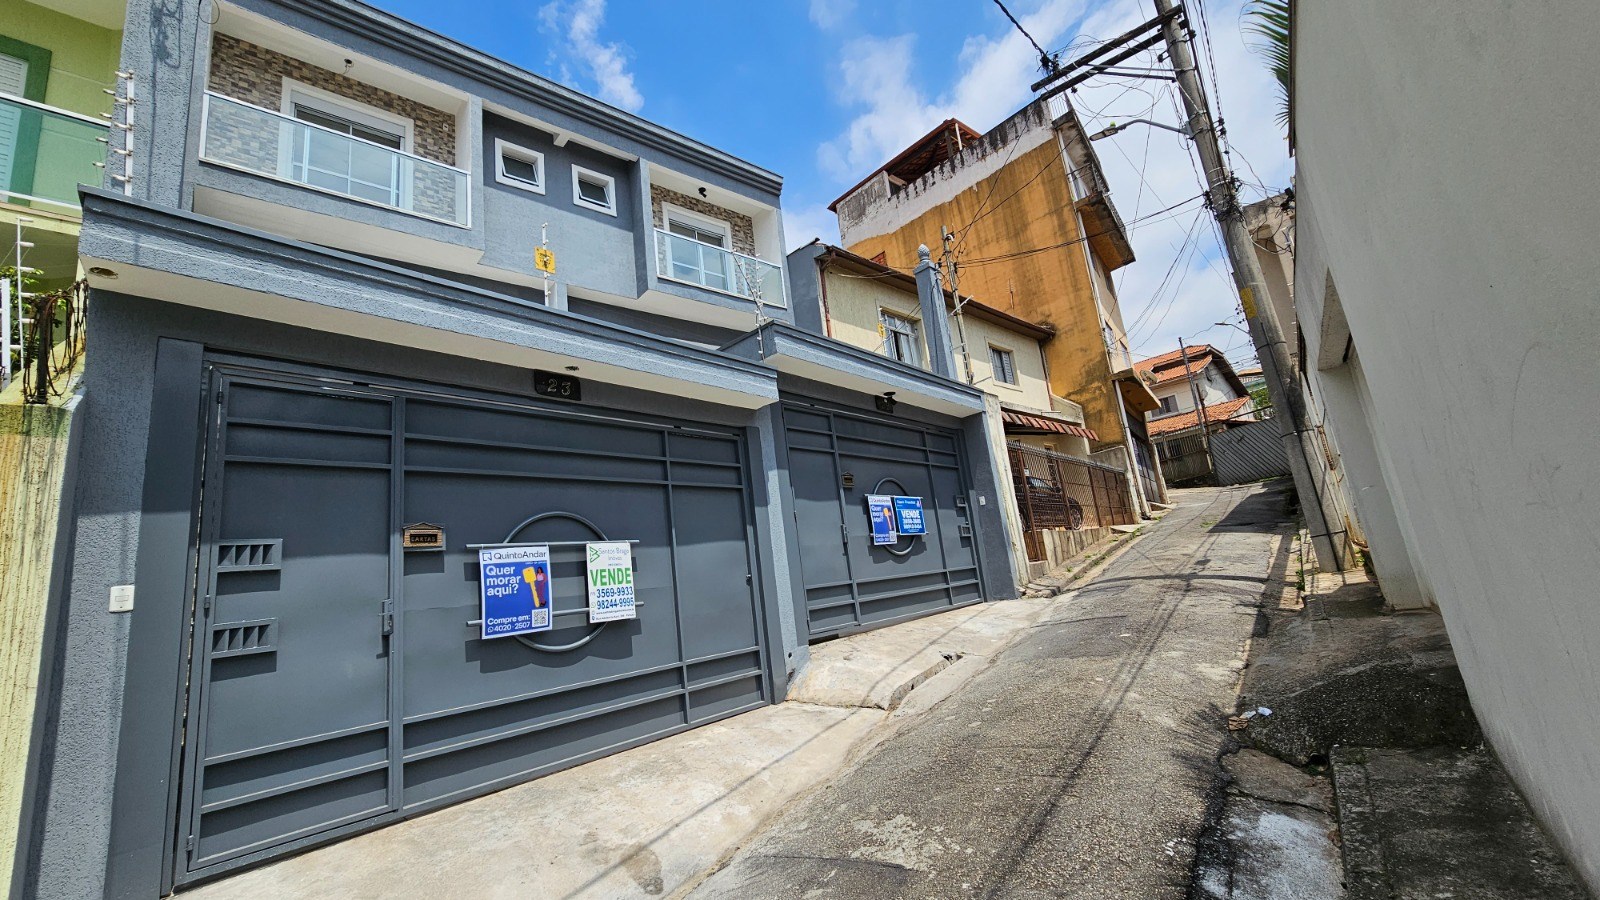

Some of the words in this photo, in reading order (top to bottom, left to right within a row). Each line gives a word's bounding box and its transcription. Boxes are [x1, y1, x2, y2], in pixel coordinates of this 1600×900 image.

[547, 378, 571, 396] 23
[901, 510, 921, 518] VENDE
[493, 550, 546, 560] QuintoAndar
[486, 565, 515, 576] Quer
[486, 575, 521, 586] morar
[590, 567, 632, 587] VENDE
[487, 584, 519, 597] aqui?
[596, 586, 633, 599] 3569-9933
[597, 597, 634, 610] 98244-9995
[487, 615, 517, 626] Compre
